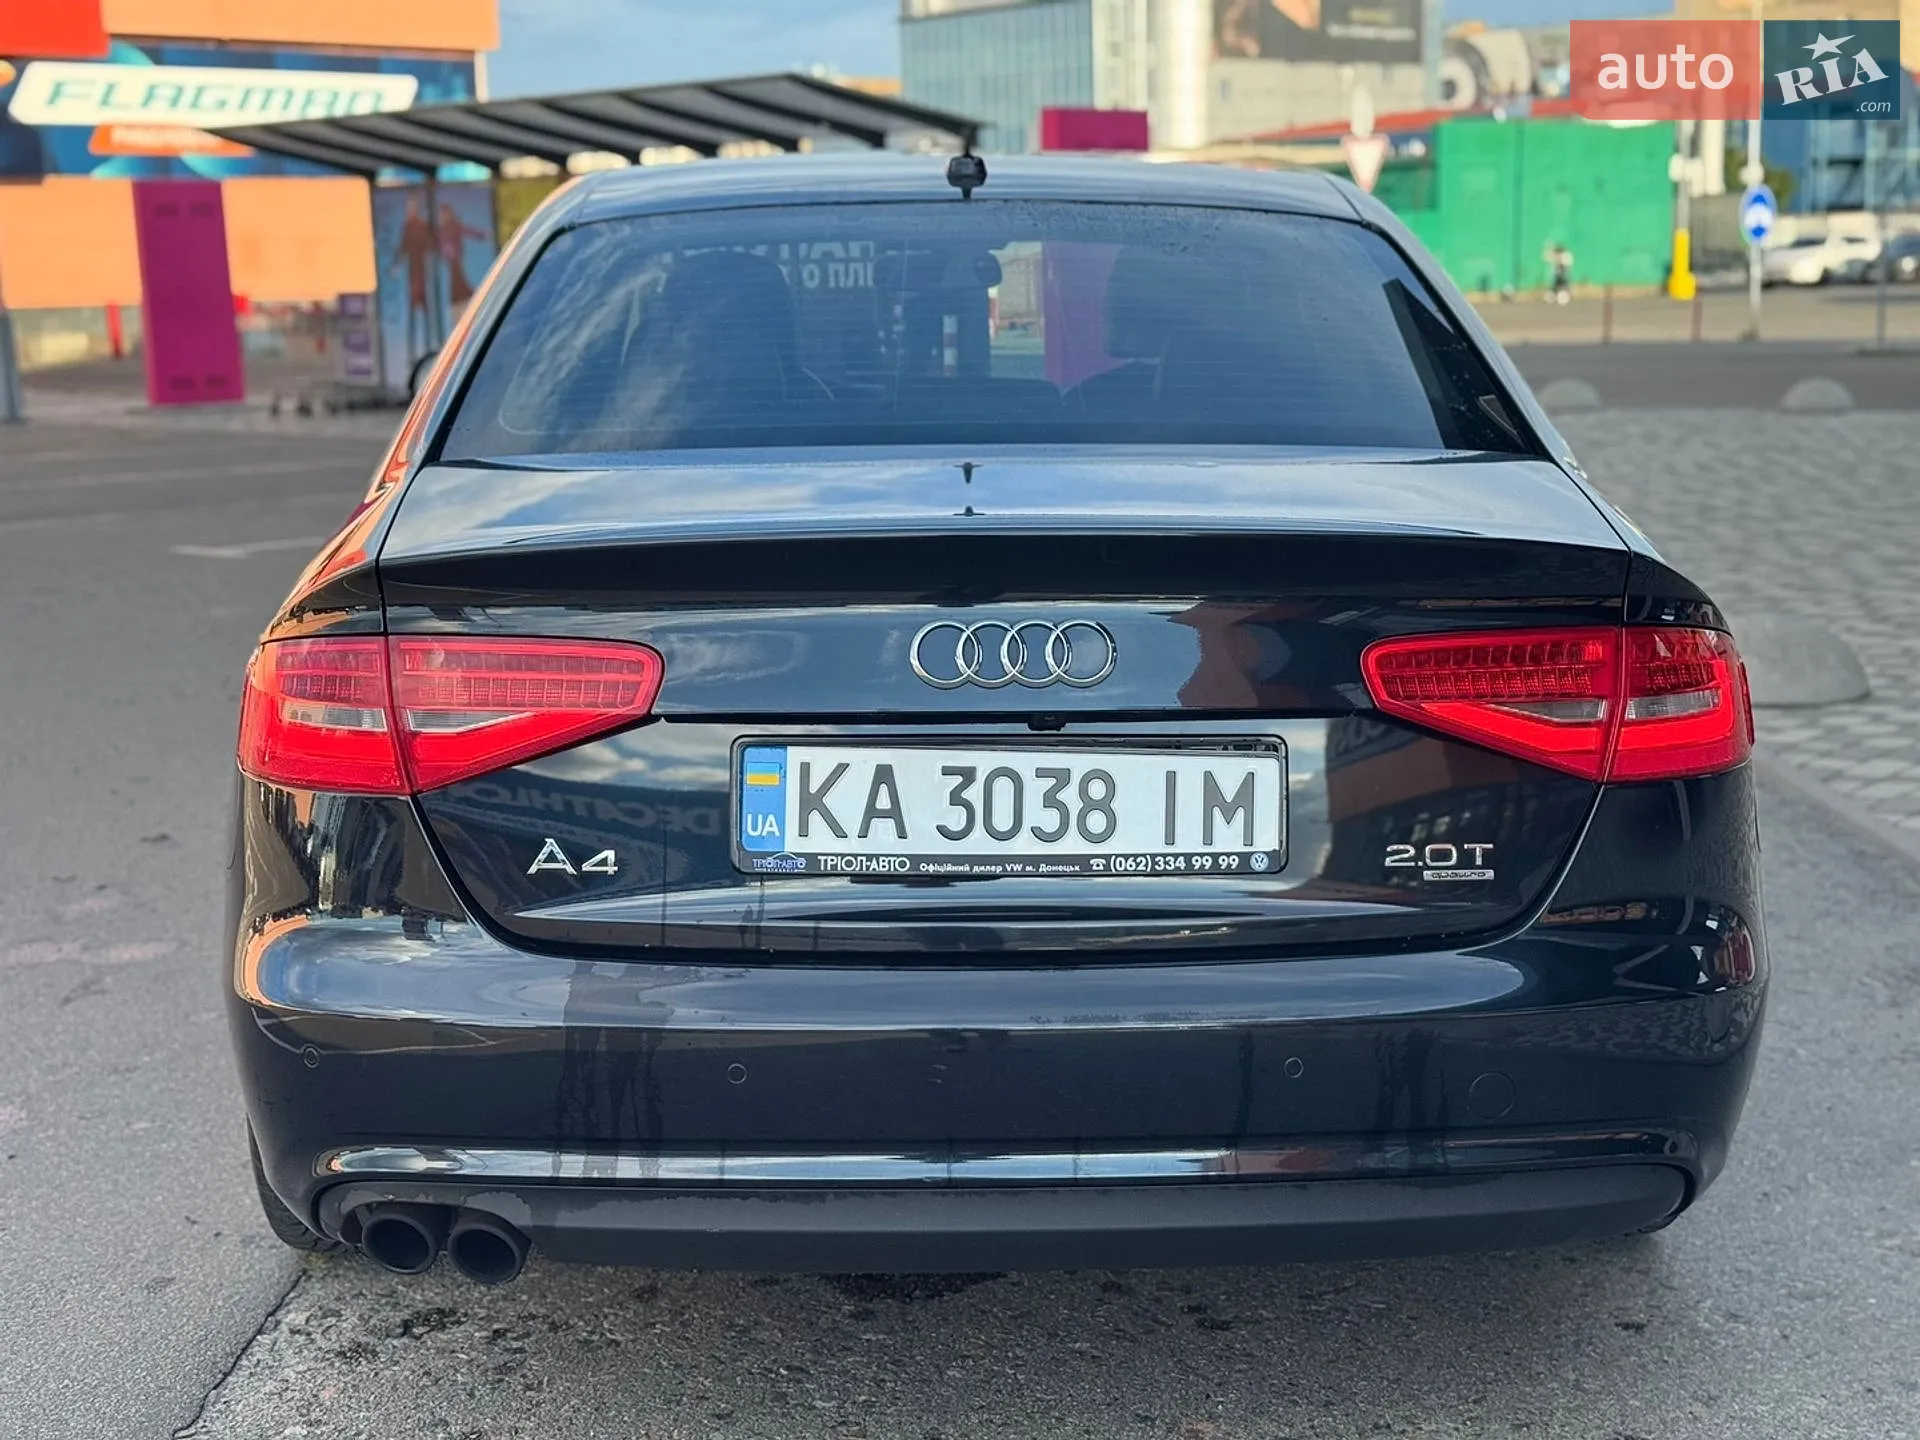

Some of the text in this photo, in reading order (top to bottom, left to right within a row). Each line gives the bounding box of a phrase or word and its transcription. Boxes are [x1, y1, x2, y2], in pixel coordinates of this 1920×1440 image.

[46, 78, 386, 118] FLAGMAN
[798, 762, 1255, 846] KA 3038 IM
[747, 814, 780, 837] UA
[526, 838, 618, 876] A4
[919, 862, 970, 873] Офіційний
[972, 864, 1003, 874] дилер
[1005, 863, 1023, 872] VW
[1039, 863, 1081, 873] Донецьк
[1110, 855, 1152, 873] (062)
[1154, 856, 1186, 870] 334
[1191, 856, 1213, 870] 99
[1218, 855, 1240, 869] 99
